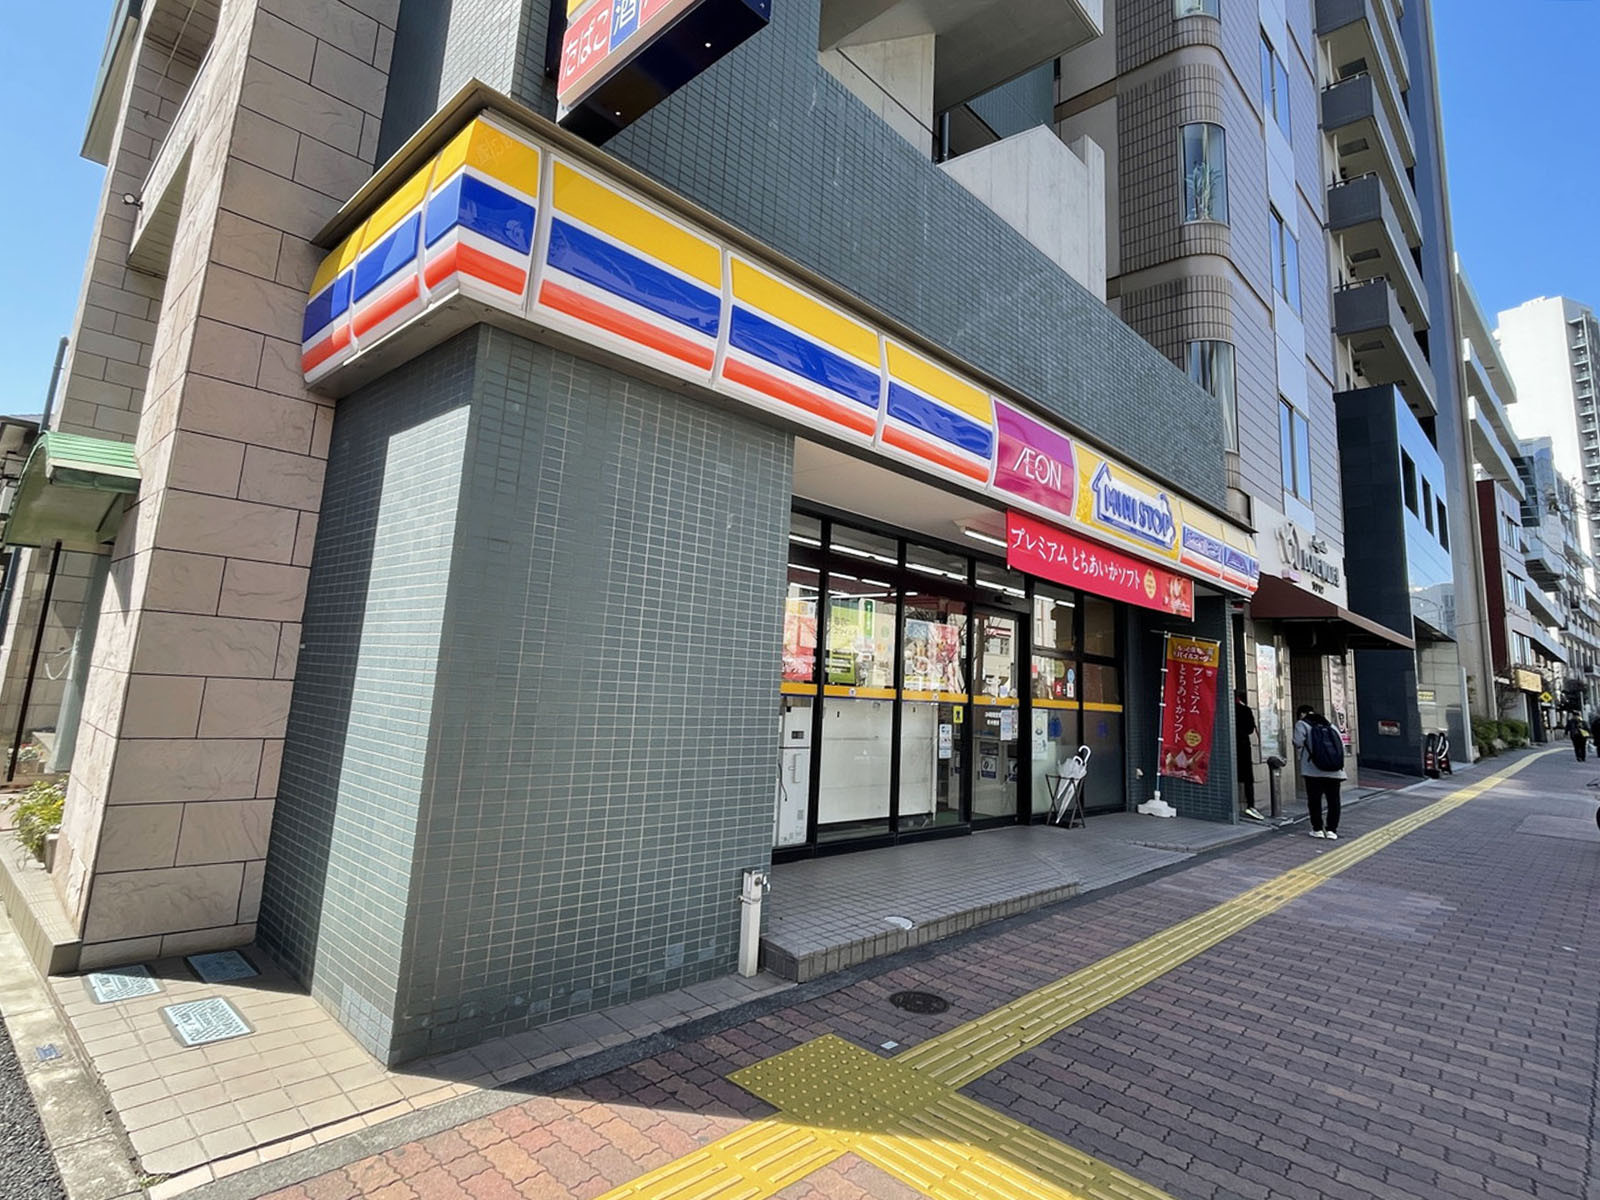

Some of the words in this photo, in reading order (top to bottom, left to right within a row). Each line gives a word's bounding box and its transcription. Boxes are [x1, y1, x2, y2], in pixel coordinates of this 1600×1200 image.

[562, 8, 609, 80] たばこ
[612, 0, 637, 36] 酒
[1104, 484, 1137, 525] MINI
[1139, 501, 1171, 538] STOP
[1010, 527, 1068, 565] プレミアム
